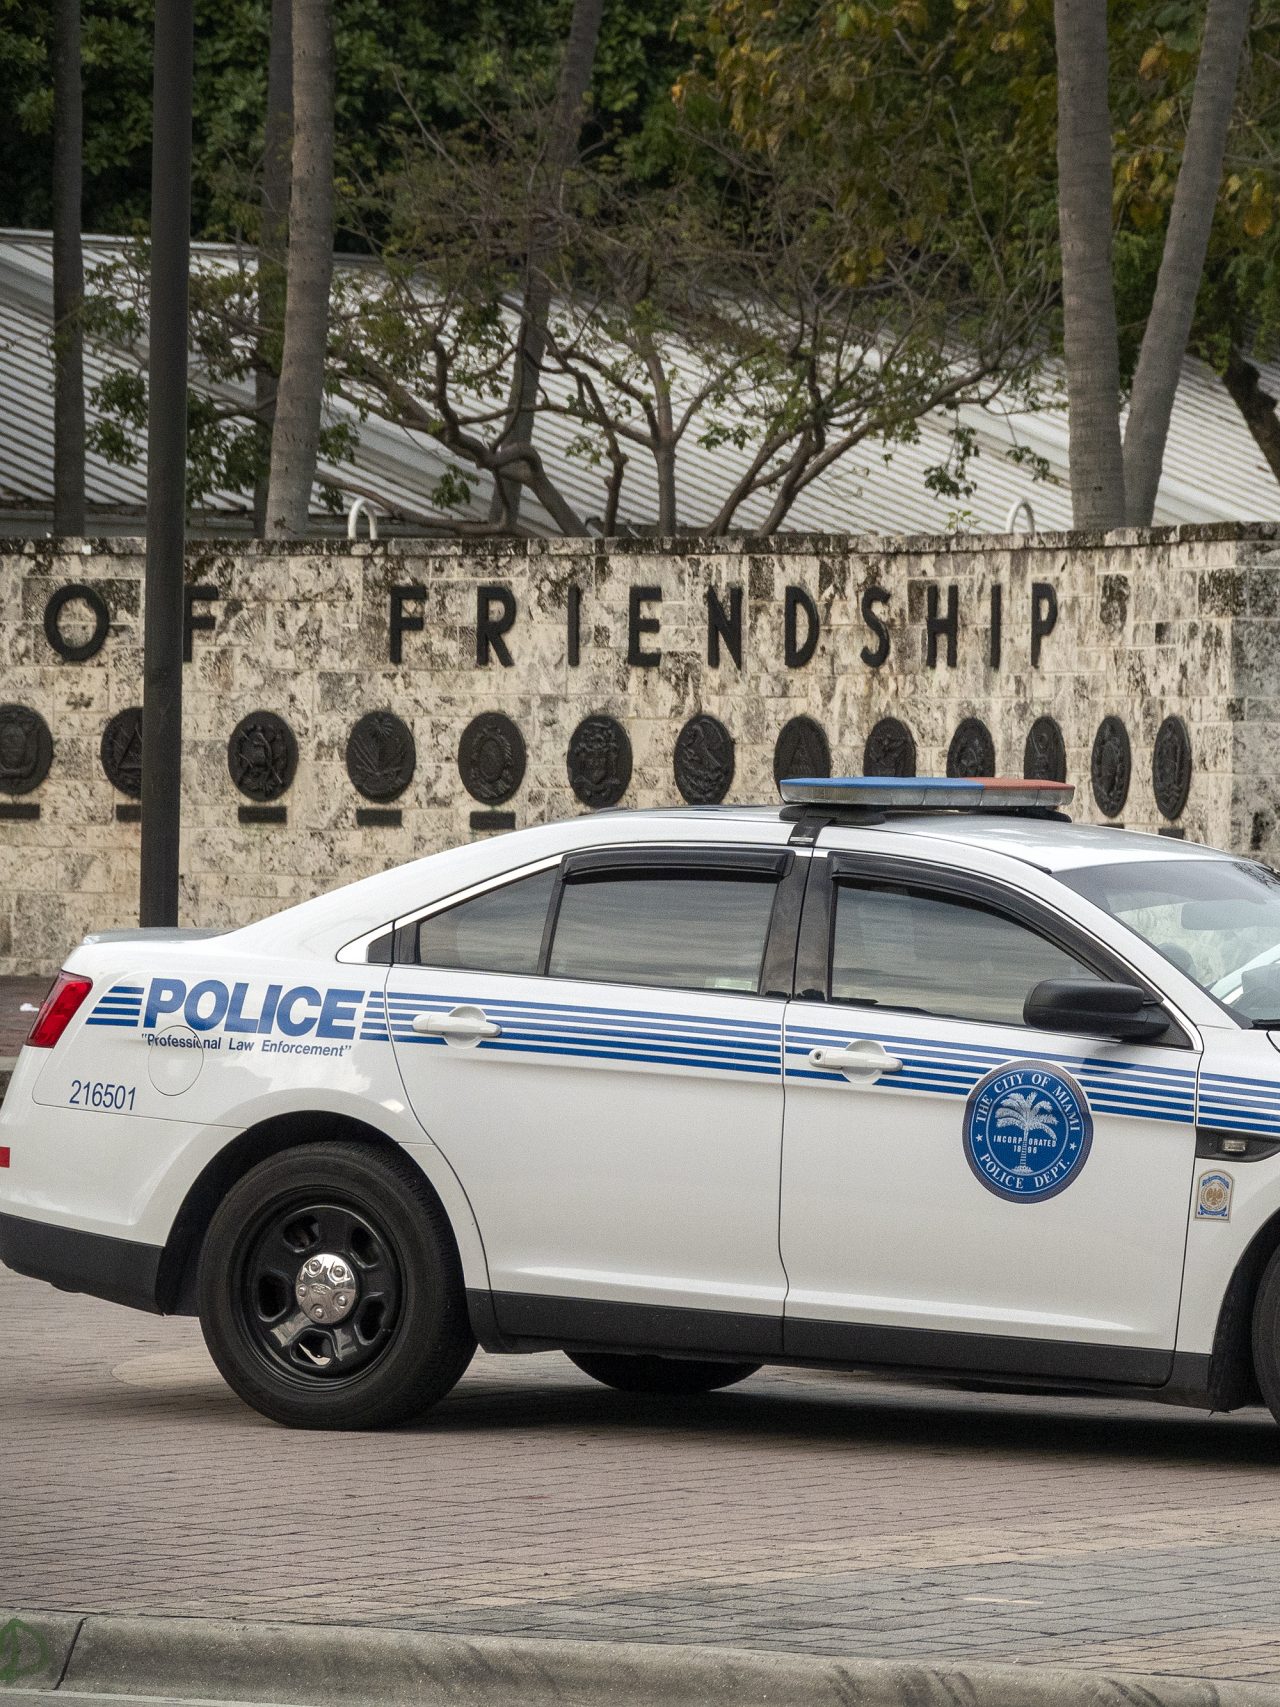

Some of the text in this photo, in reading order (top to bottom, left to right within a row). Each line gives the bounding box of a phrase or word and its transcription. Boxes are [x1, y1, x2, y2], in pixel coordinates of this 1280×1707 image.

[43, 582, 1058, 669] OF FRIENDSHIP
[143, 978, 365, 1039] POLICE
[228, 1038, 254, 1052] Law
[69, 1080, 137, 1111] 216501
[976, 1072, 1081, 1131] THE CITY OF MIAMI
[980, 1153, 1024, 1189] POLICE
